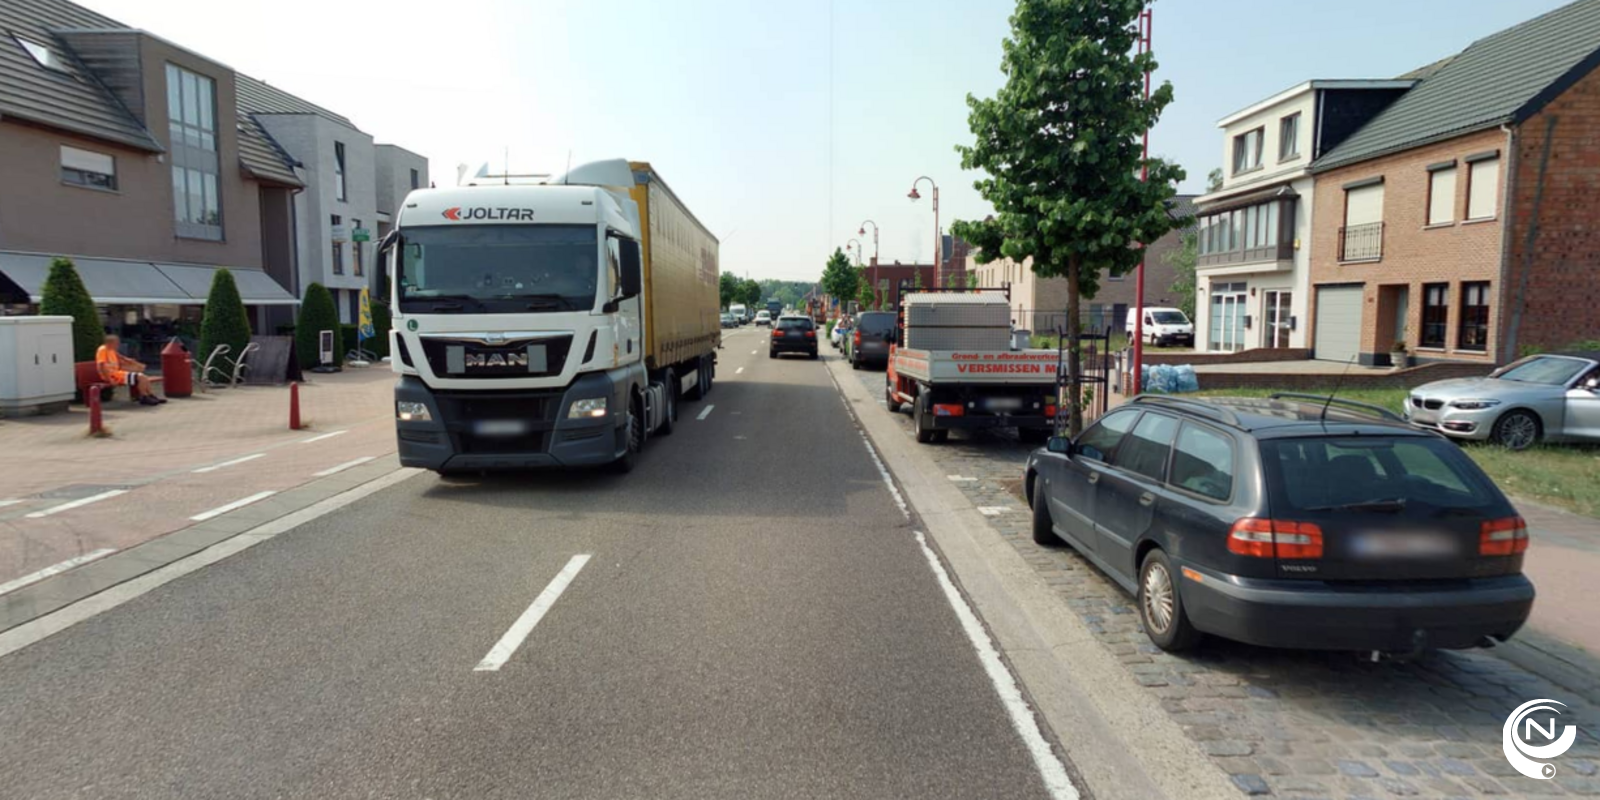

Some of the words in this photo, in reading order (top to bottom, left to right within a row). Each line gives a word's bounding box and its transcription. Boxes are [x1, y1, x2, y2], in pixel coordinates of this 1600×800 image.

[463, 207, 534, 221] JOLTAR
[466, 353, 528, 366] MAN
[957, 363, 1040, 373] VERSMISSEN
